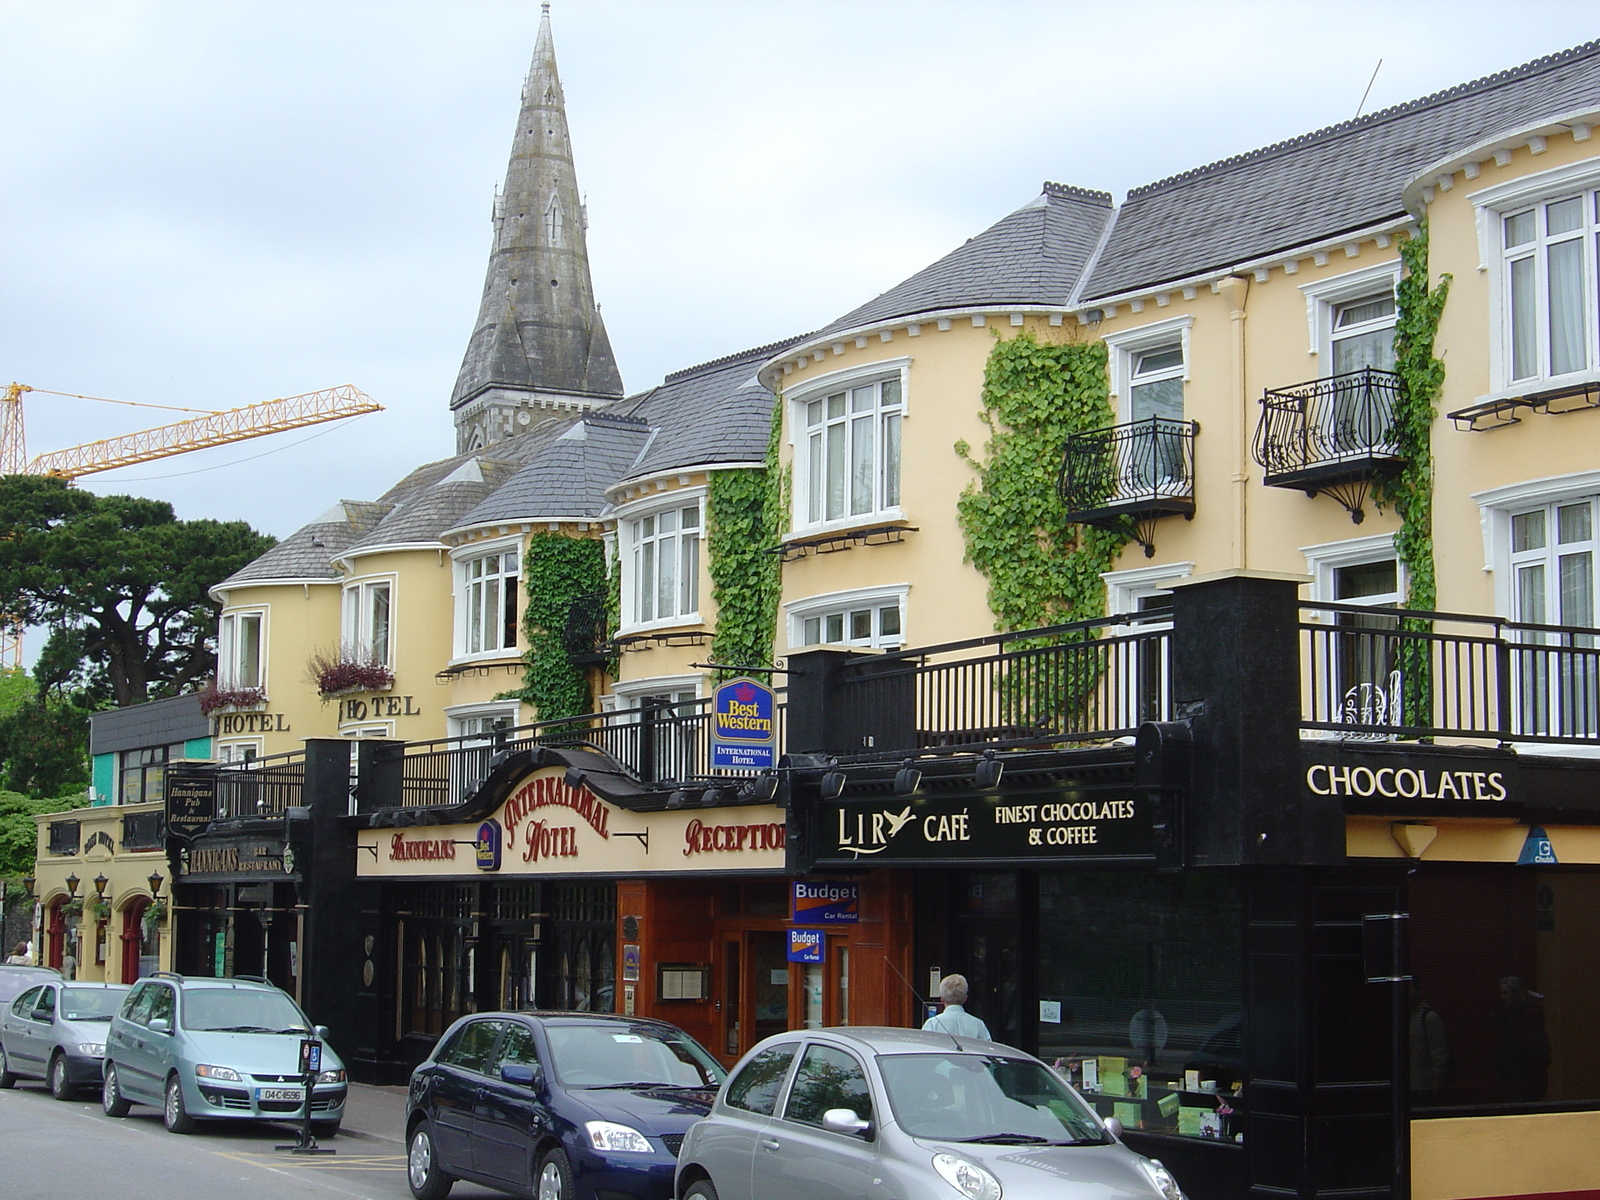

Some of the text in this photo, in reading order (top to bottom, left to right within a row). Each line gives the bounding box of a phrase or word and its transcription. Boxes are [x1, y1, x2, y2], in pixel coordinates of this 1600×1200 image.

[345, 696, 420, 721] HOTEL
[728, 700, 760, 717] Best
[223, 713, 291, 734] HOTEL
[717, 712, 772, 731] Western
[170, 787, 213, 798] Hannigans
[1306, 764, 1507, 802] CHOCOLATES
[184, 798, 201, 807] Pub
[995, 800, 1135, 824] FINEST CHOCOLATES
[170, 814, 212, 823] Restaurant
[923, 807, 971, 842] CAFÉ
[522, 818, 578, 863] HOTEL
[1046, 826, 1099, 845] COFFEE
[389, 832, 456, 861] HANNIGANS
[796, 884, 857, 902] Budget
[791, 931, 820, 946] Budget
